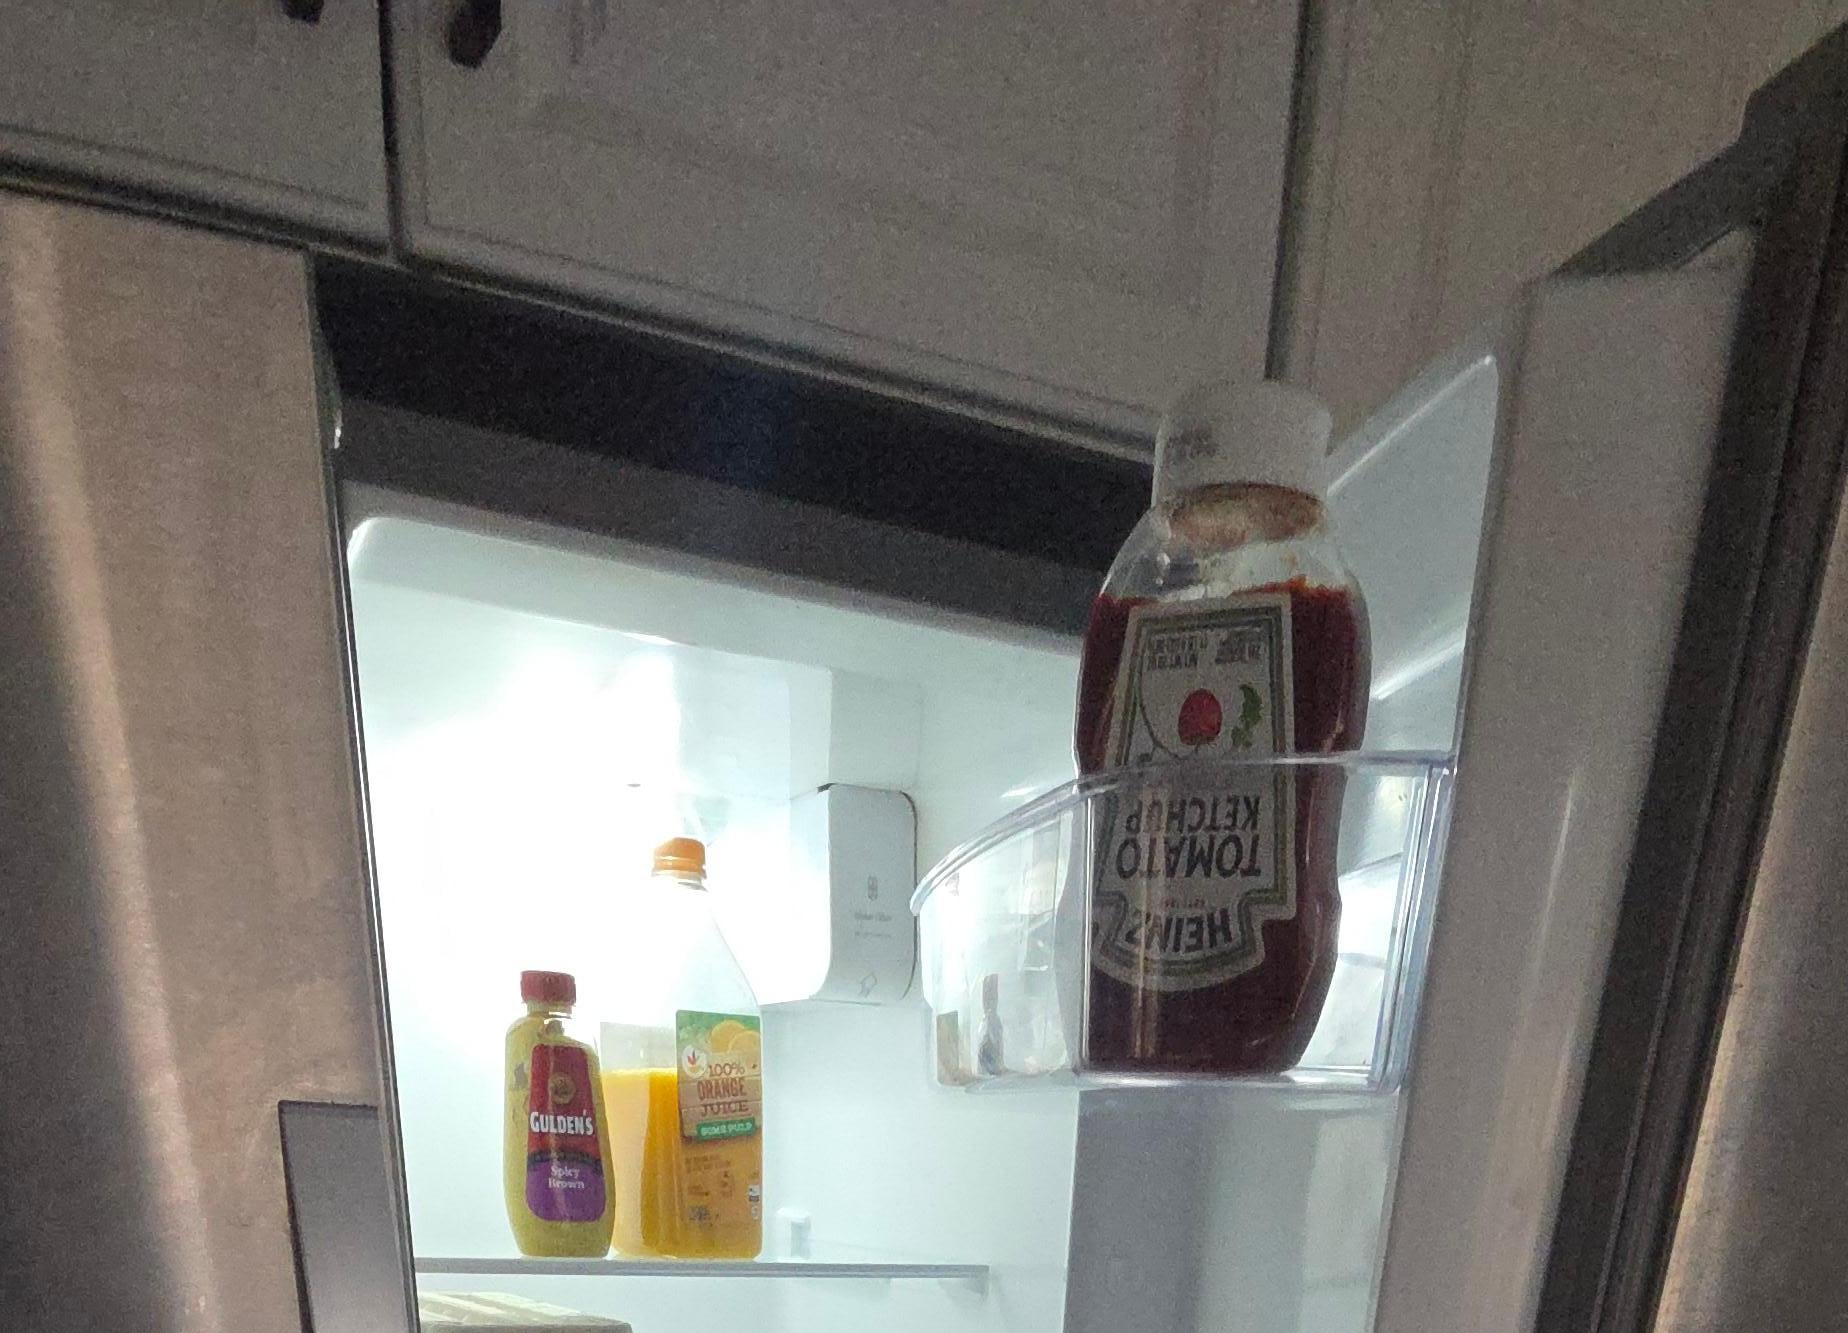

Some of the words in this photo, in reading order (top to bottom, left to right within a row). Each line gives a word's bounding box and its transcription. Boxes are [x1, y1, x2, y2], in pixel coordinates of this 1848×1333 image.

[1126, 796, 1260, 832] KETCHUP
[1116, 834, 1262, 879] TOMATO
[1125, 908, 1232, 951] HEINZ
[708, 1062, 746, 1077] 100%
[697, 1077, 747, 1100] ORANGE
[701, 1101, 749, 1117] JUICE
[530, 1109, 594, 1135] GULDEN'S
[550, 1165, 580, 1179] Spicy
